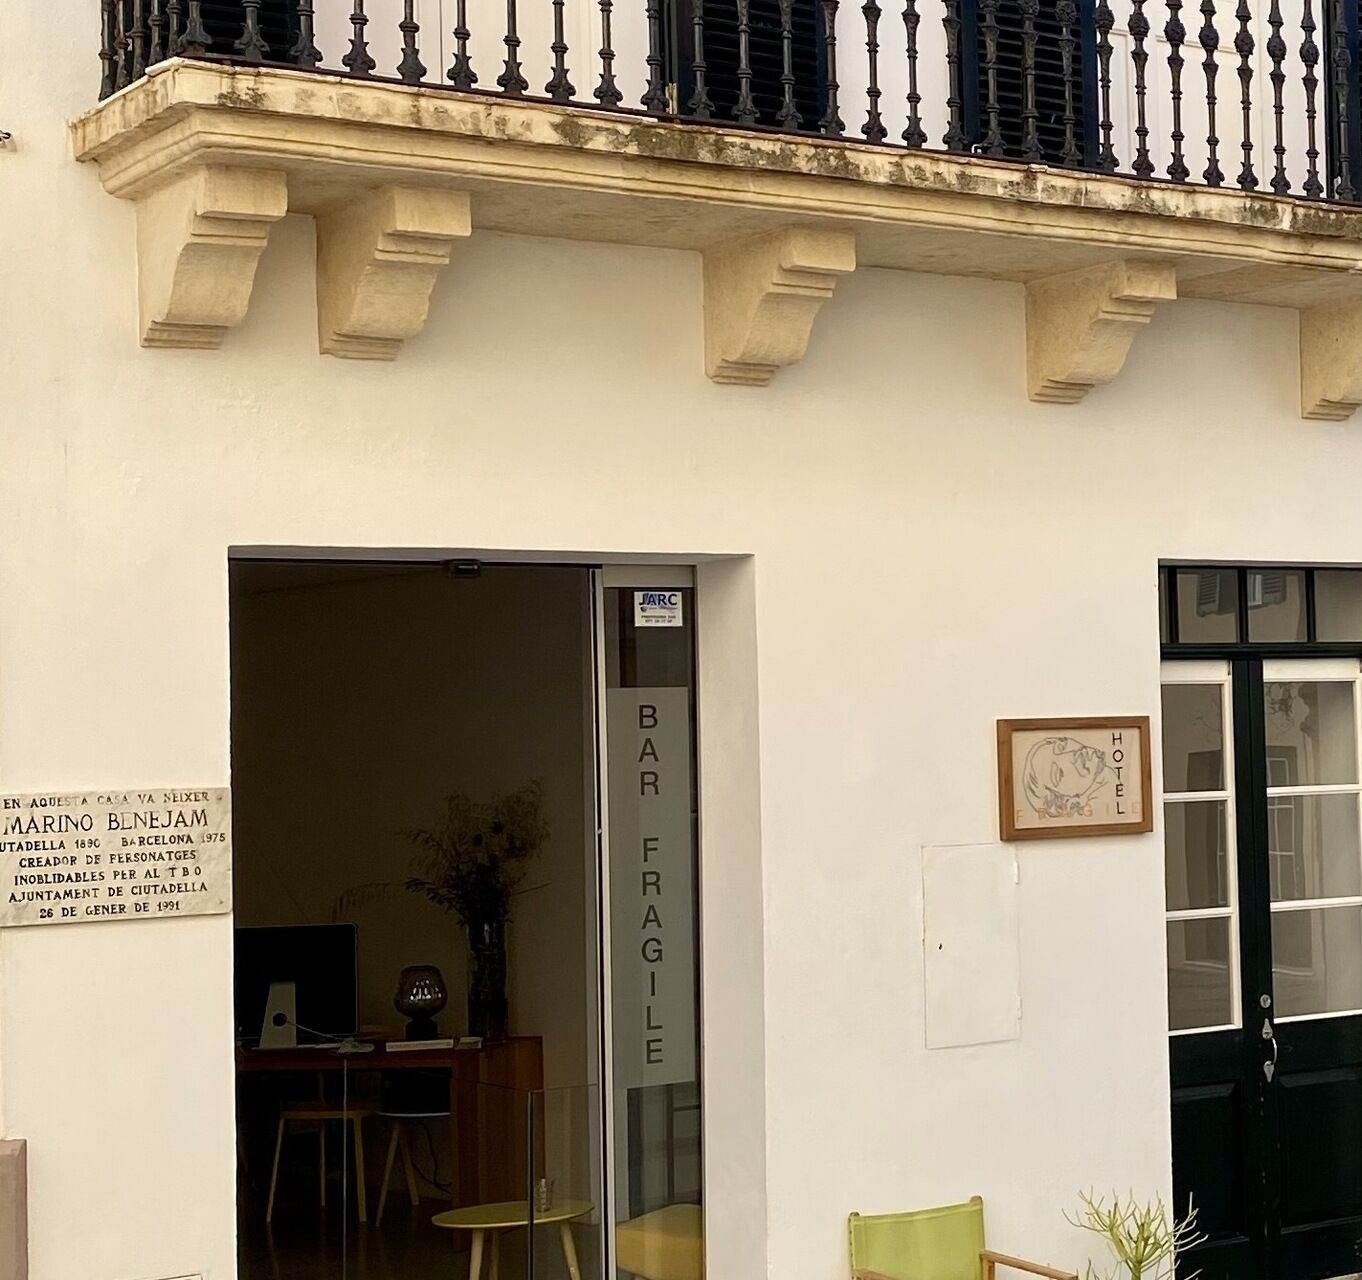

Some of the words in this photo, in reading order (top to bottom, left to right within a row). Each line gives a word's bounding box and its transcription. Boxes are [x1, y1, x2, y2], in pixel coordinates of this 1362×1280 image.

[639, 593, 678, 606] JARC
[638, 704, 659, 796] BAR
[1112, 732, 1125, 815] HOTEL
[3, 798, 21, 810] EN
[30, 795, 88, 809] AQUESTA
[97, 794, 130, 806] CASA
[137, 793, 155, 805] VA
[163, 791, 209, 803] NEIXER
[3, 813, 94, 835] MARINO
[107, 808, 208, 831] BENEJAM
[75, 838, 101, 850] 1890
[121, 834, 195, 847] BARCELONA
[201, 832, 226, 843] 1975
[19, 855, 77, 868] CREADOR
[86, 854, 101, 865] DE
[109, 849, 196, 864] PERSONATGES
[14, 871, 105, 886] INOBLIDABLES
[113, 869, 136, 880] PER
[144, 868, 160, 879] AL
[9, 887, 100, 903] AJUNTAMENT
[107, 886, 123, 897] DE
[131, 881, 208, 895] CIUTADELLA
[39, 908, 54, 919] 26
[61, 906, 77, 917] DE
[85, 904, 127, 916] GENER
[134, 902, 150, 913] DE
[157, 900, 180, 912] 1991
[641, 837, 663, 1065] FRAGILE
